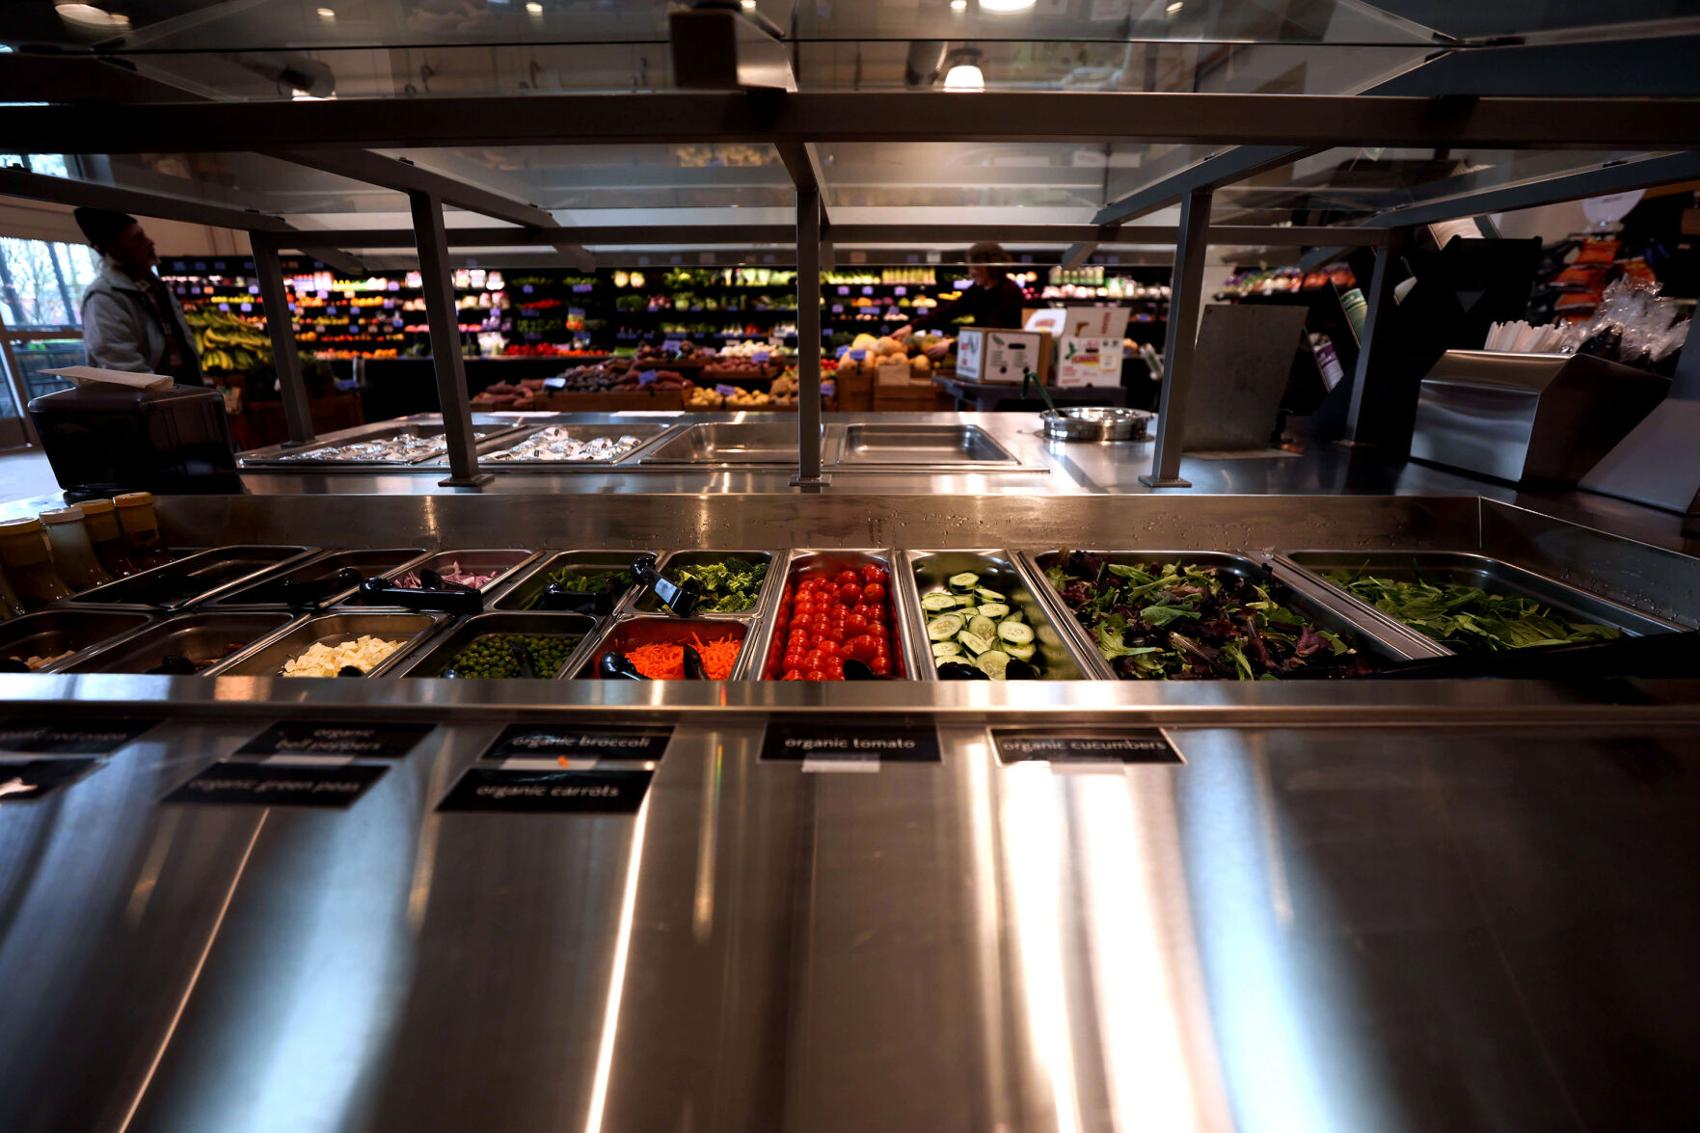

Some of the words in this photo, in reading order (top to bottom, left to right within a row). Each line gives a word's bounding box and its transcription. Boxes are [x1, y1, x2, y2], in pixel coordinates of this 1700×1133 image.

[511, 734, 575, 748] organic
[578, 735, 651, 748] broccoli
[784, 736, 849, 750] organic
[853, 737, 917, 749] tomato
[1003, 739, 1068, 752] organic
[1071, 739, 1167, 750] cucumbers
[475, 784, 549, 799] organic
[550, 784, 620, 797] carrots
